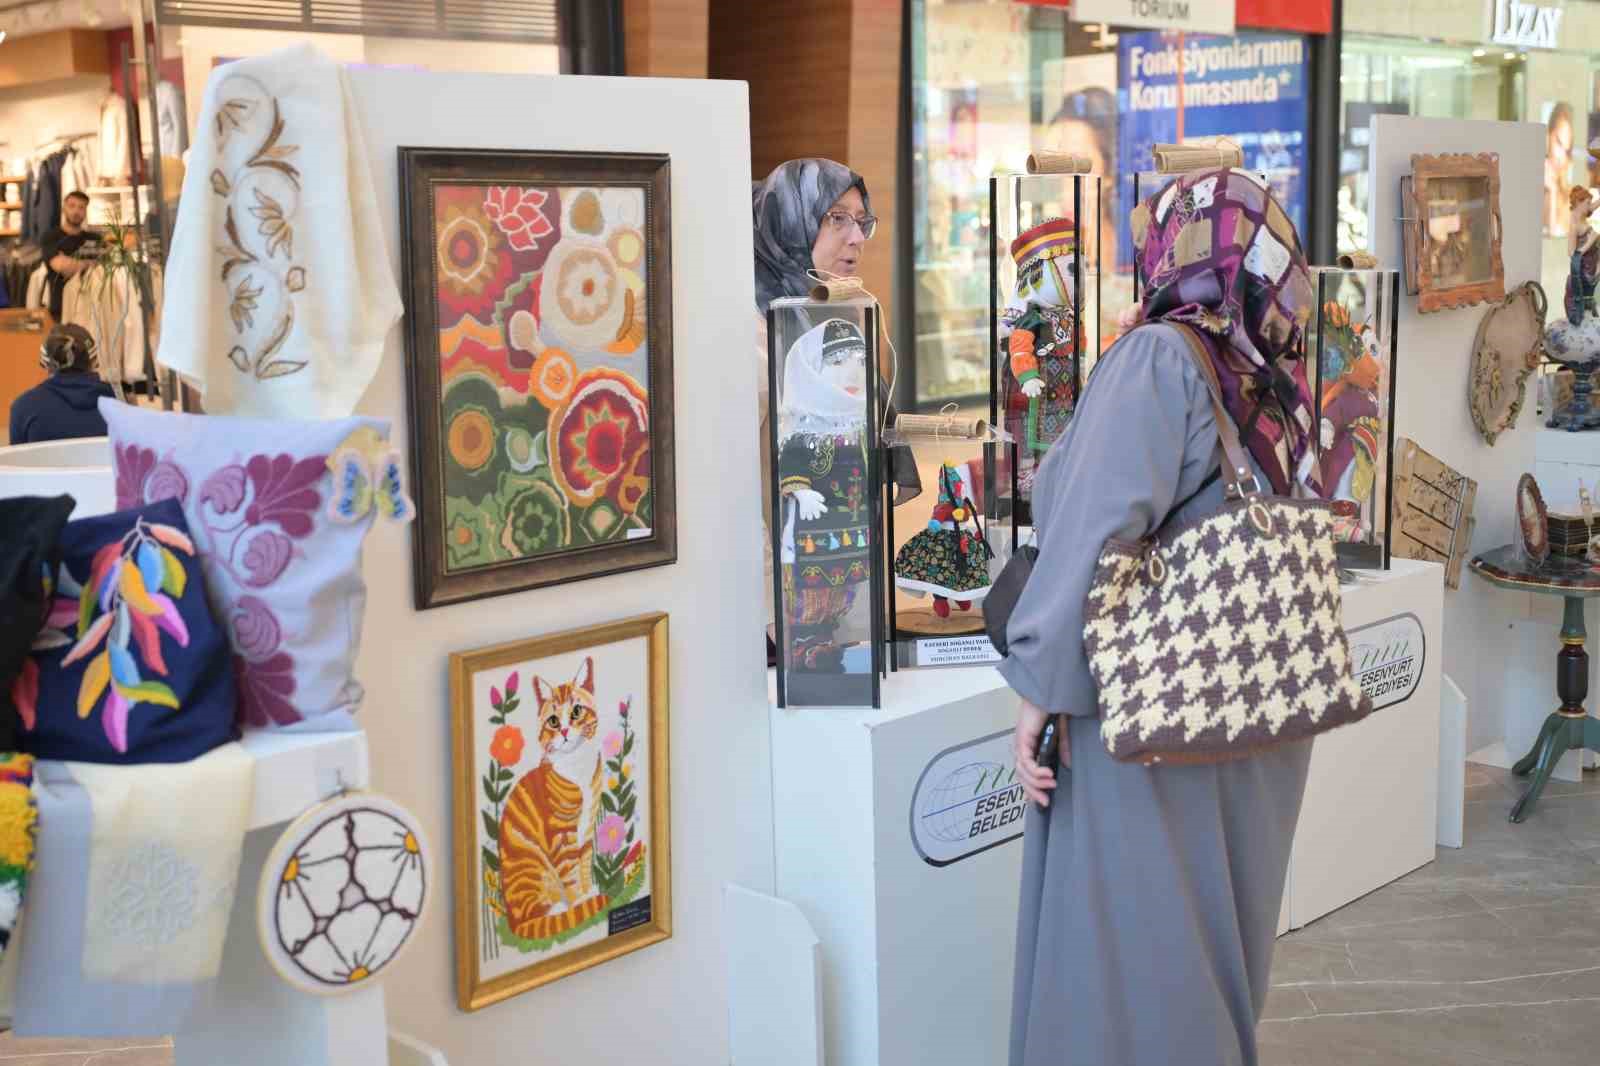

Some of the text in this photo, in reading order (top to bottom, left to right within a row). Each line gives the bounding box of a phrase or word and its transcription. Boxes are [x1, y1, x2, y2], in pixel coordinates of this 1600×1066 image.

[1130, 69, 1291, 111] Korumasında
[1360, 658, 1414, 687] ESENYURT
[975, 785, 1025, 817] ESENY
